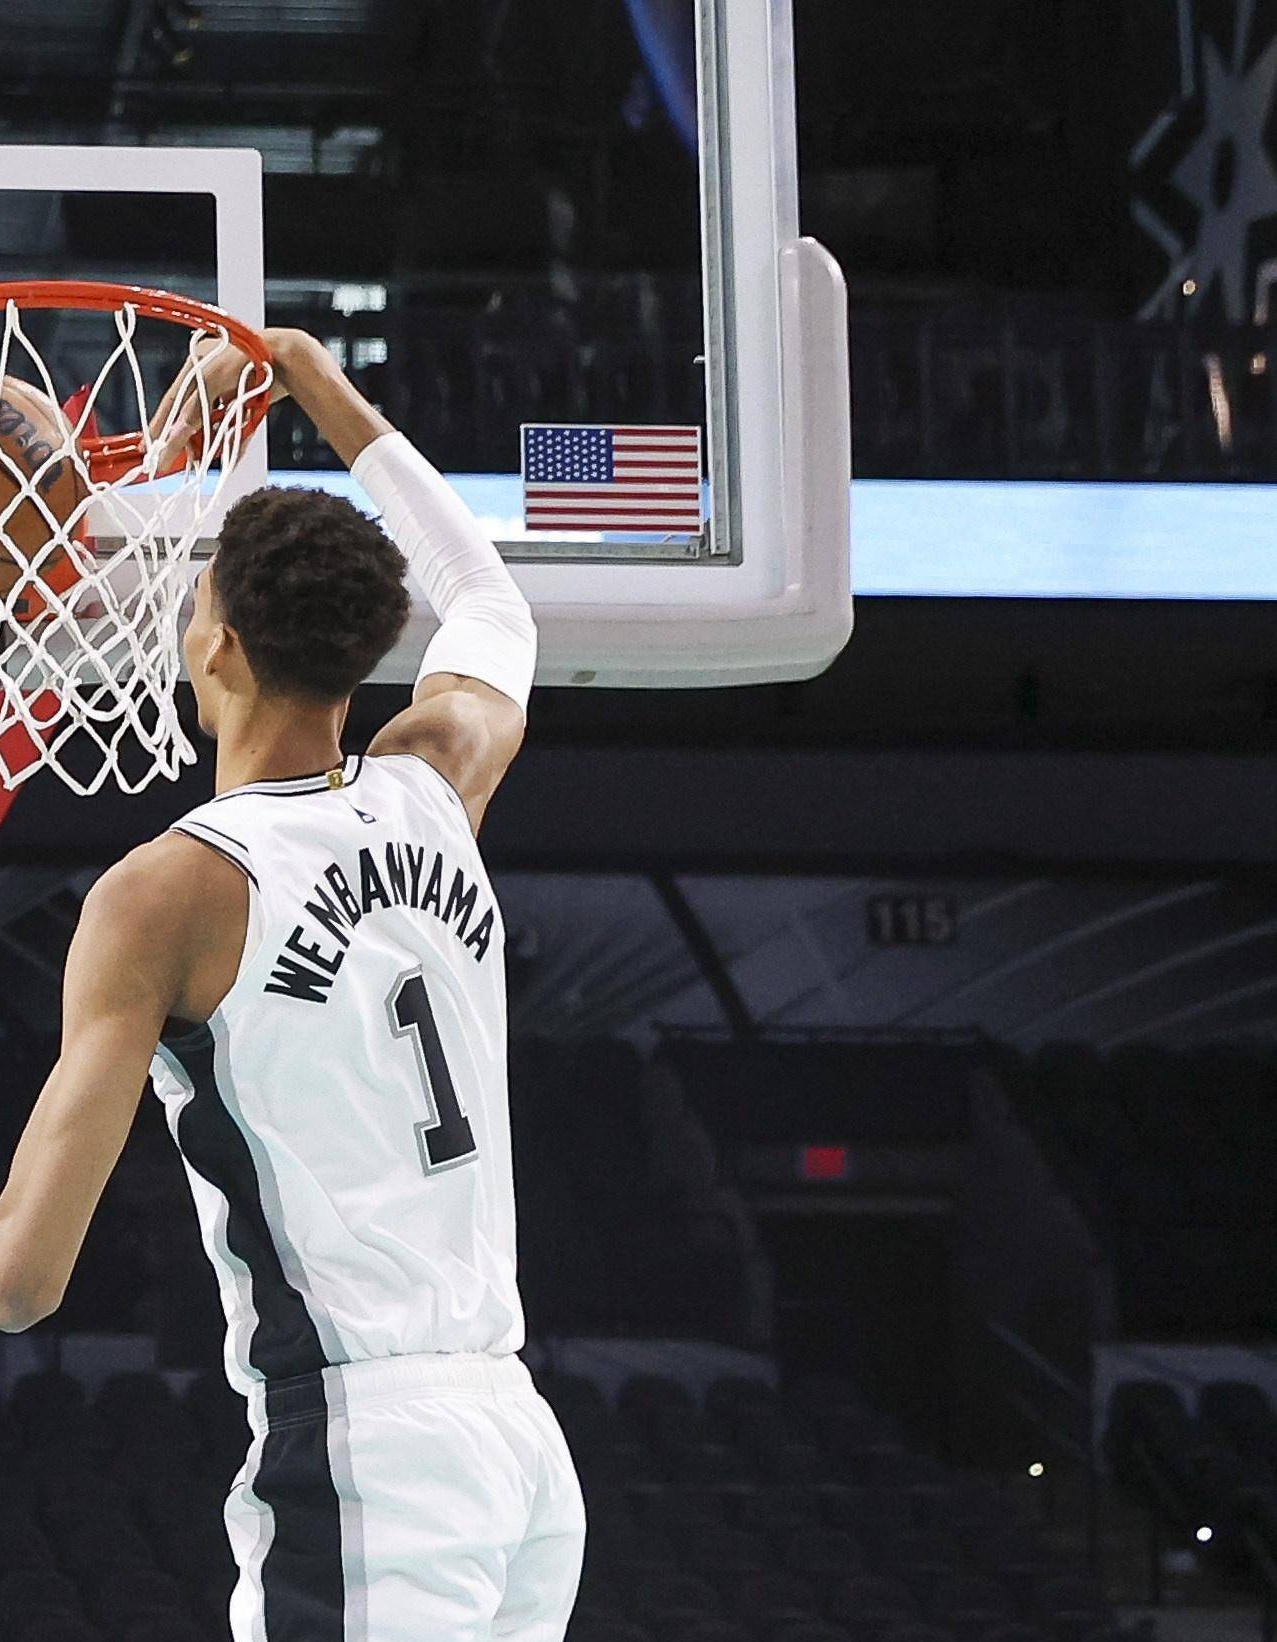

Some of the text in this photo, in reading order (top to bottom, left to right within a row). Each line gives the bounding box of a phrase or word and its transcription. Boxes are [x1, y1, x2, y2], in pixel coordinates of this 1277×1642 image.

[263, 841, 495, 1004] WEMBANYAMA
[877, 902, 951, 941] 115
[384, 963, 479, 1177] 1
